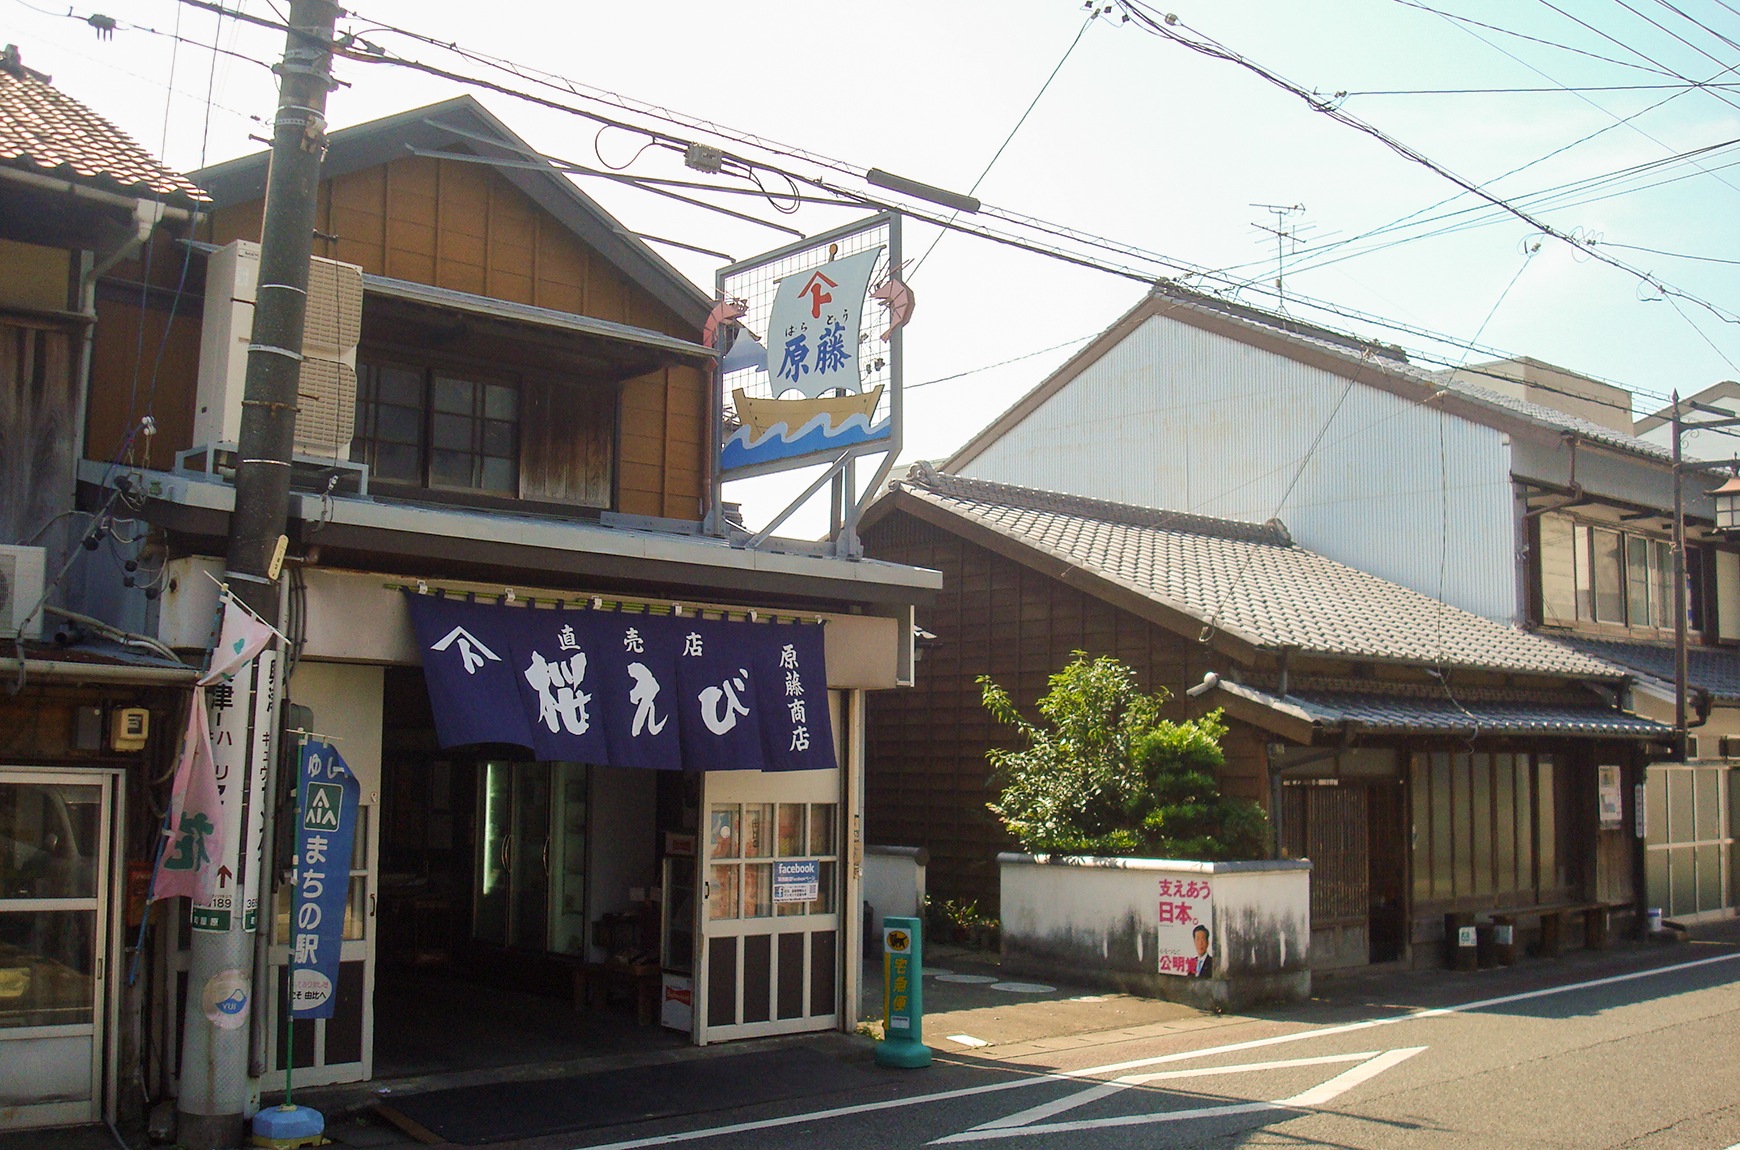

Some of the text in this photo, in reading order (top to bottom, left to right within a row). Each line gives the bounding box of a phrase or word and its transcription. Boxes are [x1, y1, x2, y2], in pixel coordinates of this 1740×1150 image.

[785, 308, 849, 338] はら とう
[776, 321, 852, 383] 原藤
[558, 623, 704, 657] 直売店
[524, 650, 751, 738] 桜えび
[778, 643, 811, 752] 原藤商店
[778, 862, 816, 875] facebook
[1158, 878, 1211, 900] 支えあう
[294, 834, 328, 965] まちの駅
[893, 957, 908, 1012] 宅急便
[222, 1003, 237, 1011] YUI
